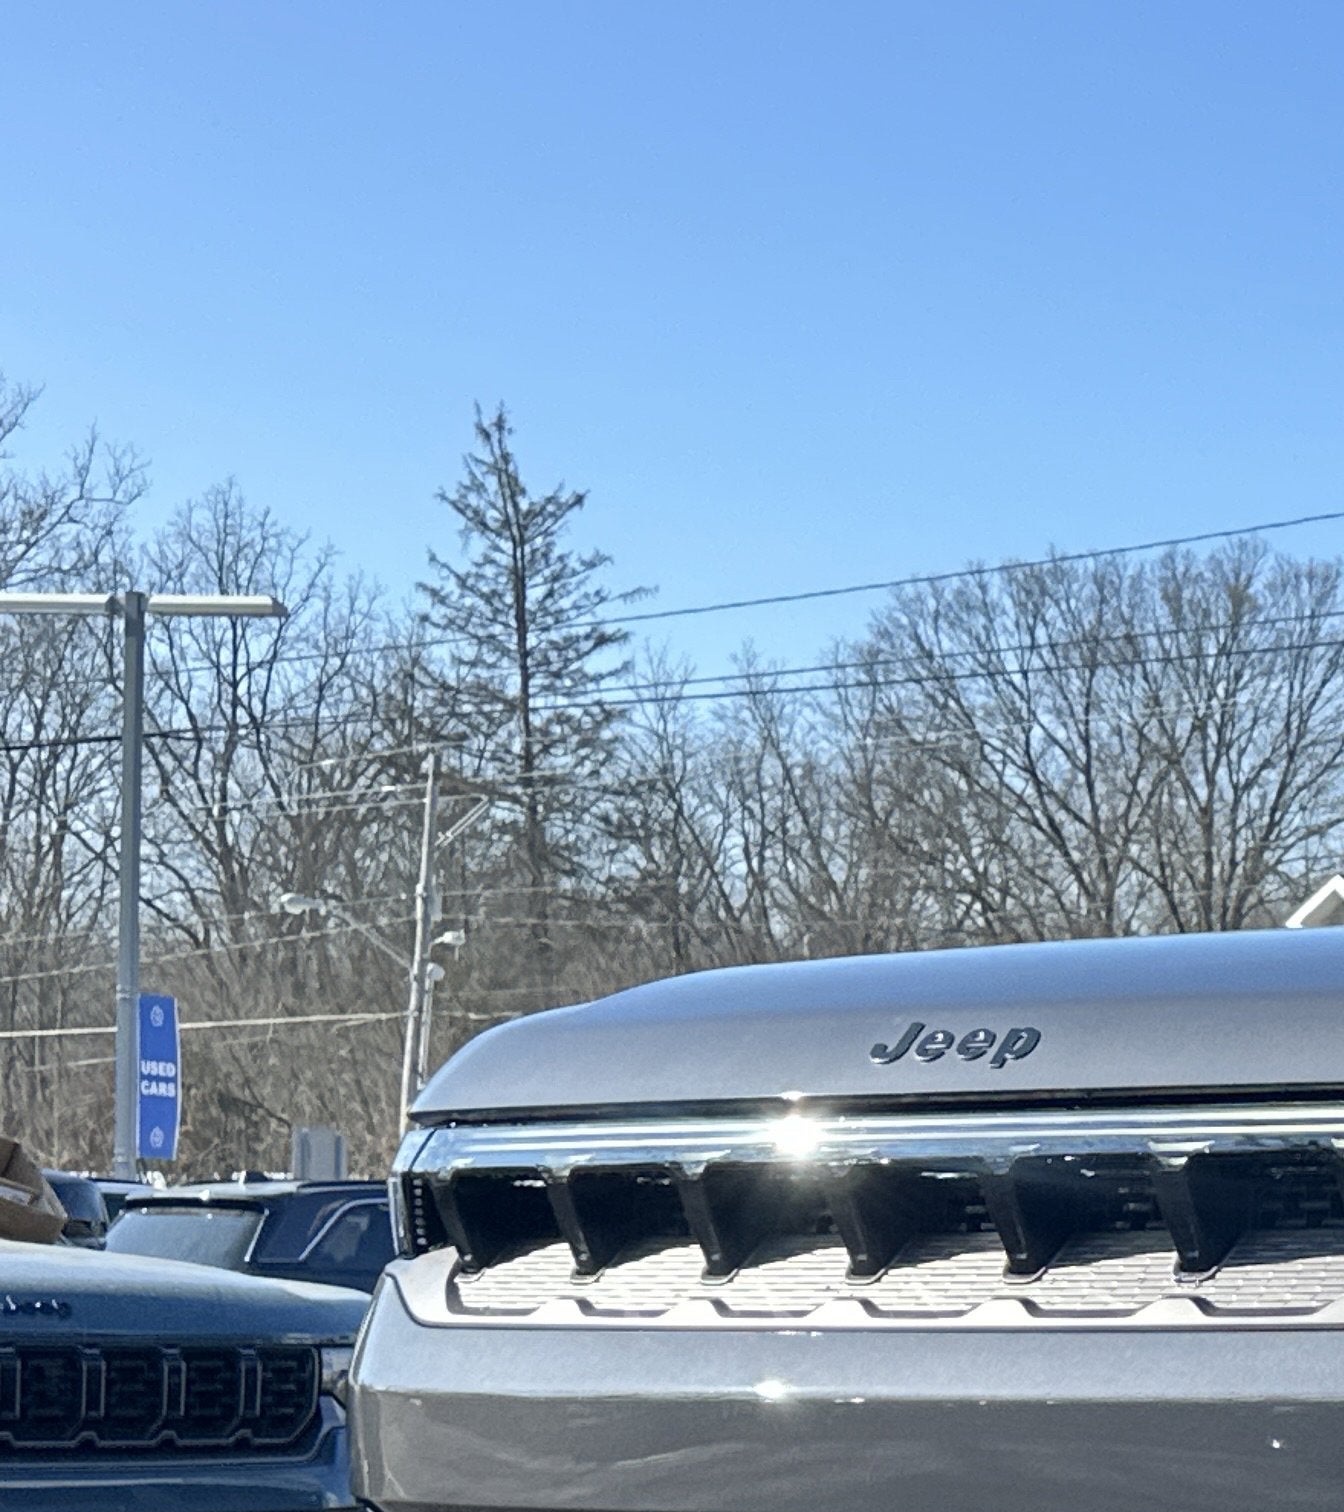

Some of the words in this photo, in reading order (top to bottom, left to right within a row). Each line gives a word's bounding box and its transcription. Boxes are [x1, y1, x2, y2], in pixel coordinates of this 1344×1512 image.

[869, 1021, 1042, 1070] Jeep
[141, 1060, 177, 1078] USED
[141, 1079, 177, 1098] CARS
